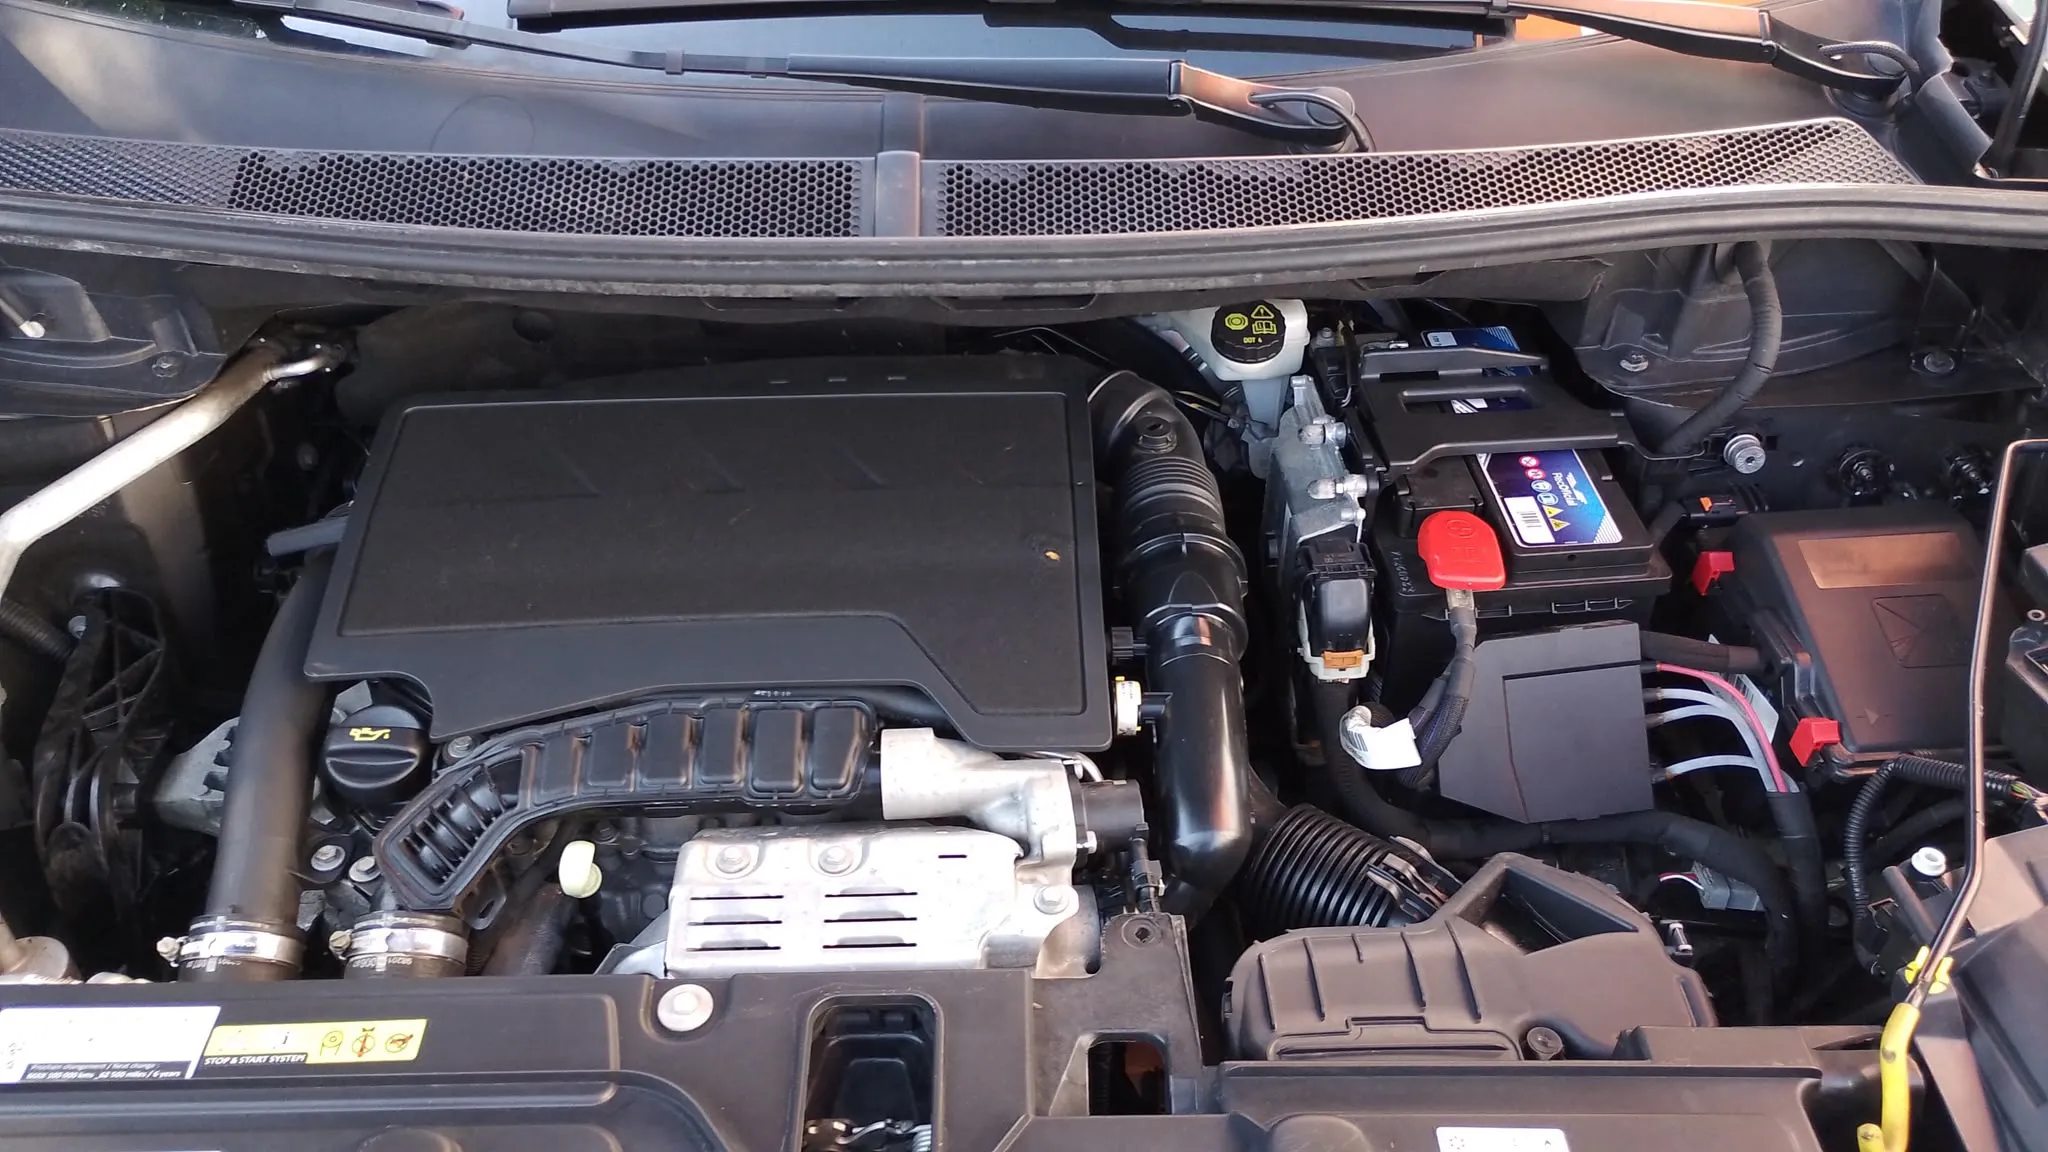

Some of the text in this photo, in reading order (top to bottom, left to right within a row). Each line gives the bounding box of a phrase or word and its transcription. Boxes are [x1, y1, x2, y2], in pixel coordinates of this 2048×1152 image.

[1243, 336, 1256, 344] DOT
[204, 1054, 307, 1065] STOP & START SYSTEM
[124, 1070, 149, 1079] miles
[159, 1070, 182, 1079] years
